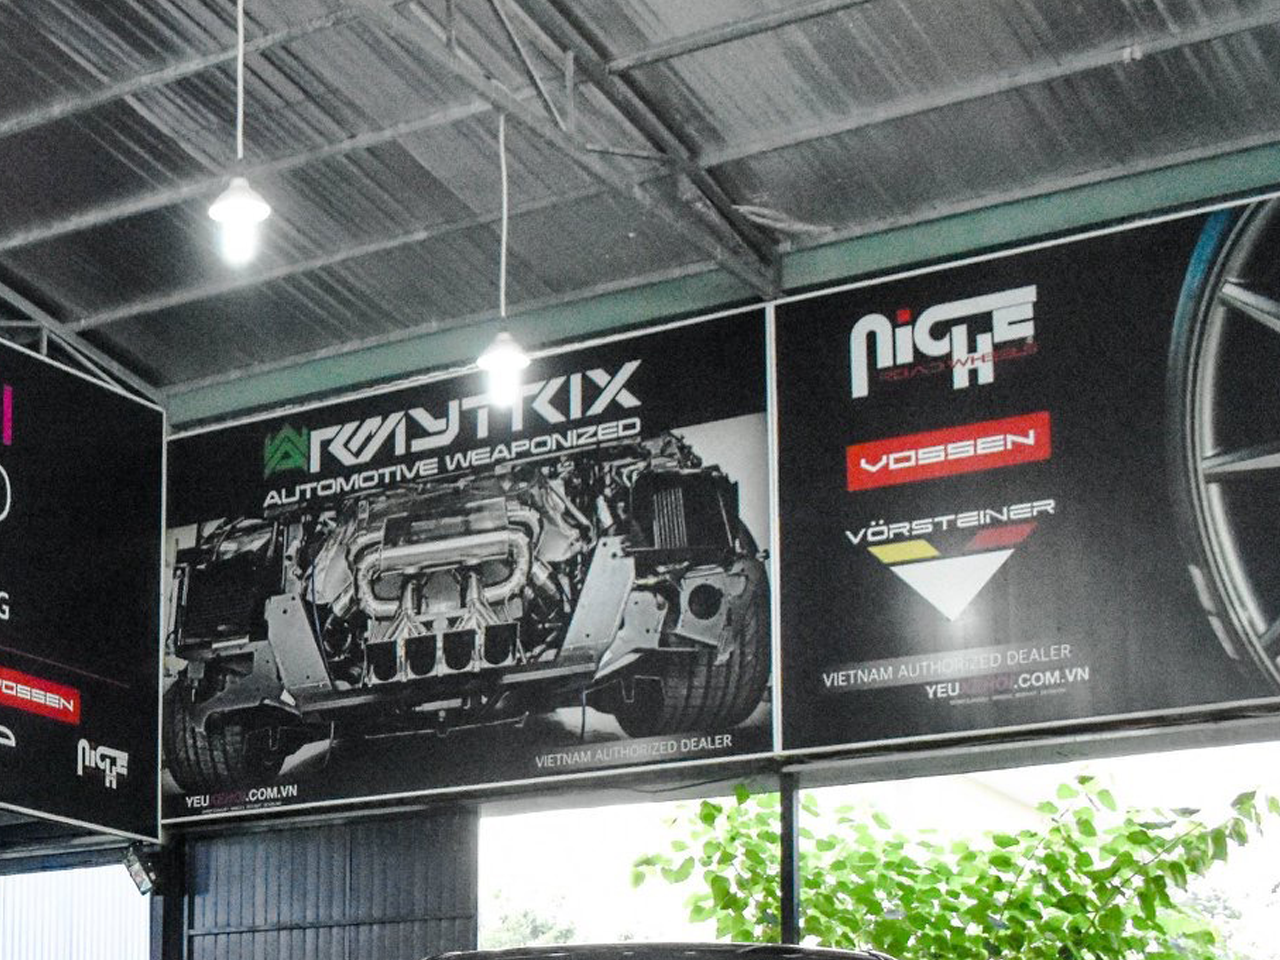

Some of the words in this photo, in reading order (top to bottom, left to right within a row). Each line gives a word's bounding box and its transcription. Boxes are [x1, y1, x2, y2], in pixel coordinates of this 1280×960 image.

[263, 459, 439, 509] AUTOMOTIVE
[445, 417, 641, 471] WEAPONIZED
[860, 429, 1035, 473] VOSSEN
[845, 499, 1056, 545] VÖRSTEINER
[822, 664, 893, 688] VIETNAM
[898, 653, 1001, 678] AUTHORIZED
[1006, 644, 1071, 666] DEALER
[925, 667, 1090, 700] YEUXOI.COM.VN
[535, 750, 591, 768] VIETNAM
[595, 740, 677, 762] AUTHORIZED
[680, 734, 733, 752] DEALER
[185, 784, 298, 809] YEU.COM.VN
